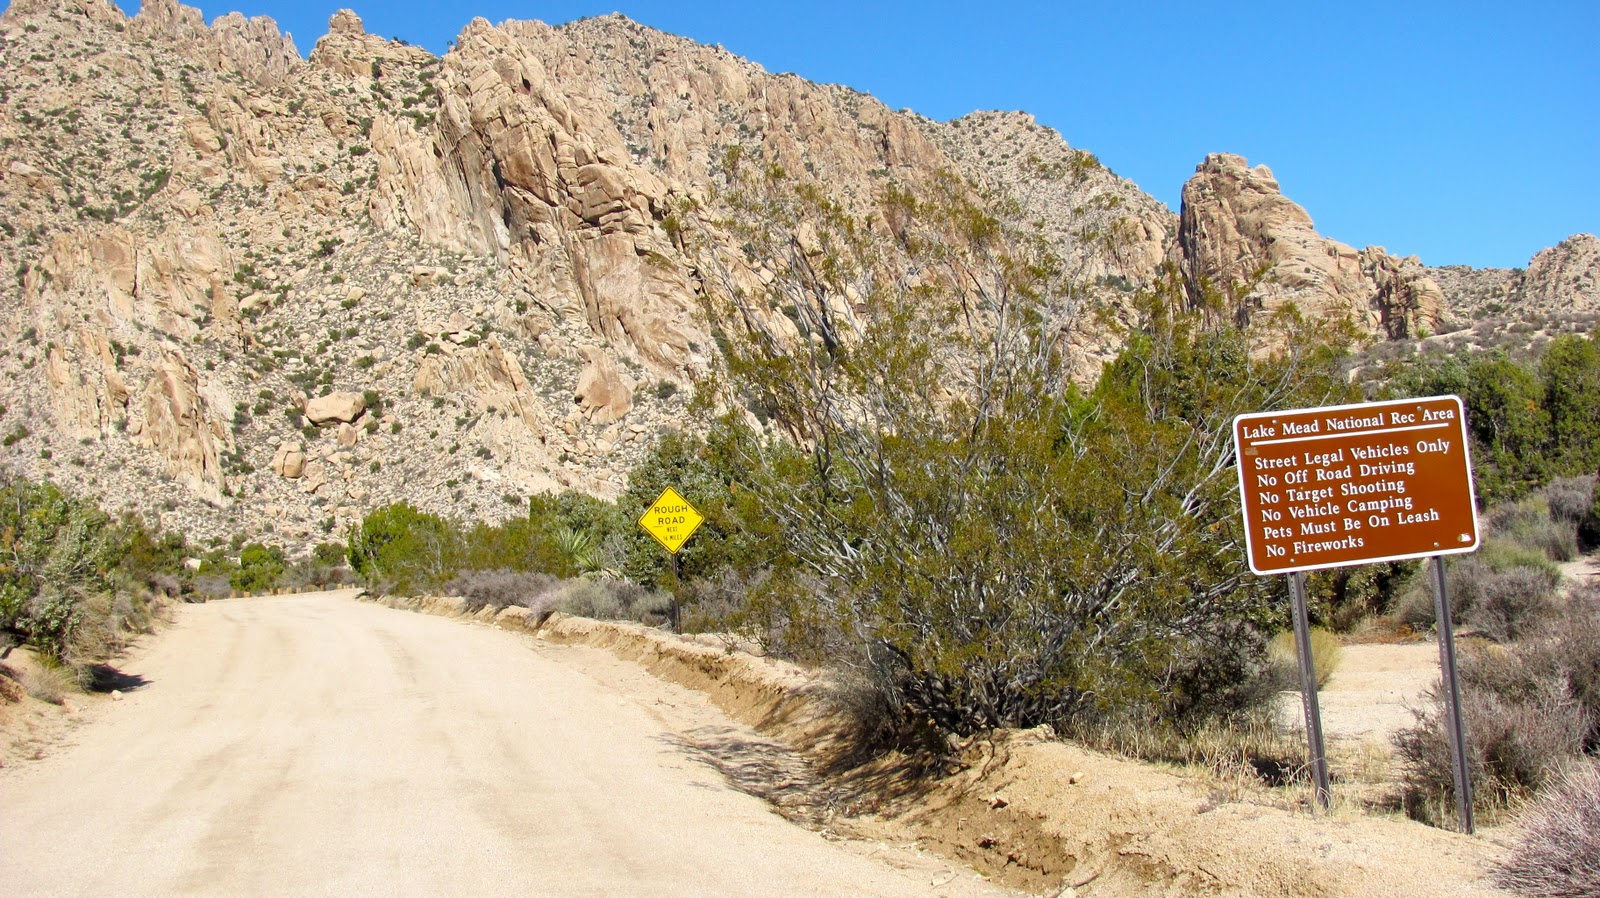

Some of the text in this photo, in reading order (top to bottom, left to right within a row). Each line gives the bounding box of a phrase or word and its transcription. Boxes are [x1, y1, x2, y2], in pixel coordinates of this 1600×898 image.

[1243, 409, 1454, 439] Lake Mead National Rec Area
[1255, 438, 1450, 470] Street Legal Vehicles Only
[1257, 461, 1415, 487] No Off Road Driving
[1259, 479, 1405, 505] No Target Shooting
[654, 505, 688, 514] ROUGH
[658, 516, 685, 525] ROAD
[1261, 496, 1413, 522] No Vehicle Camping
[1263, 508, 1440, 539] Pets Must Be On Leash
[1266, 535, 1364, 558] No Fireworks
